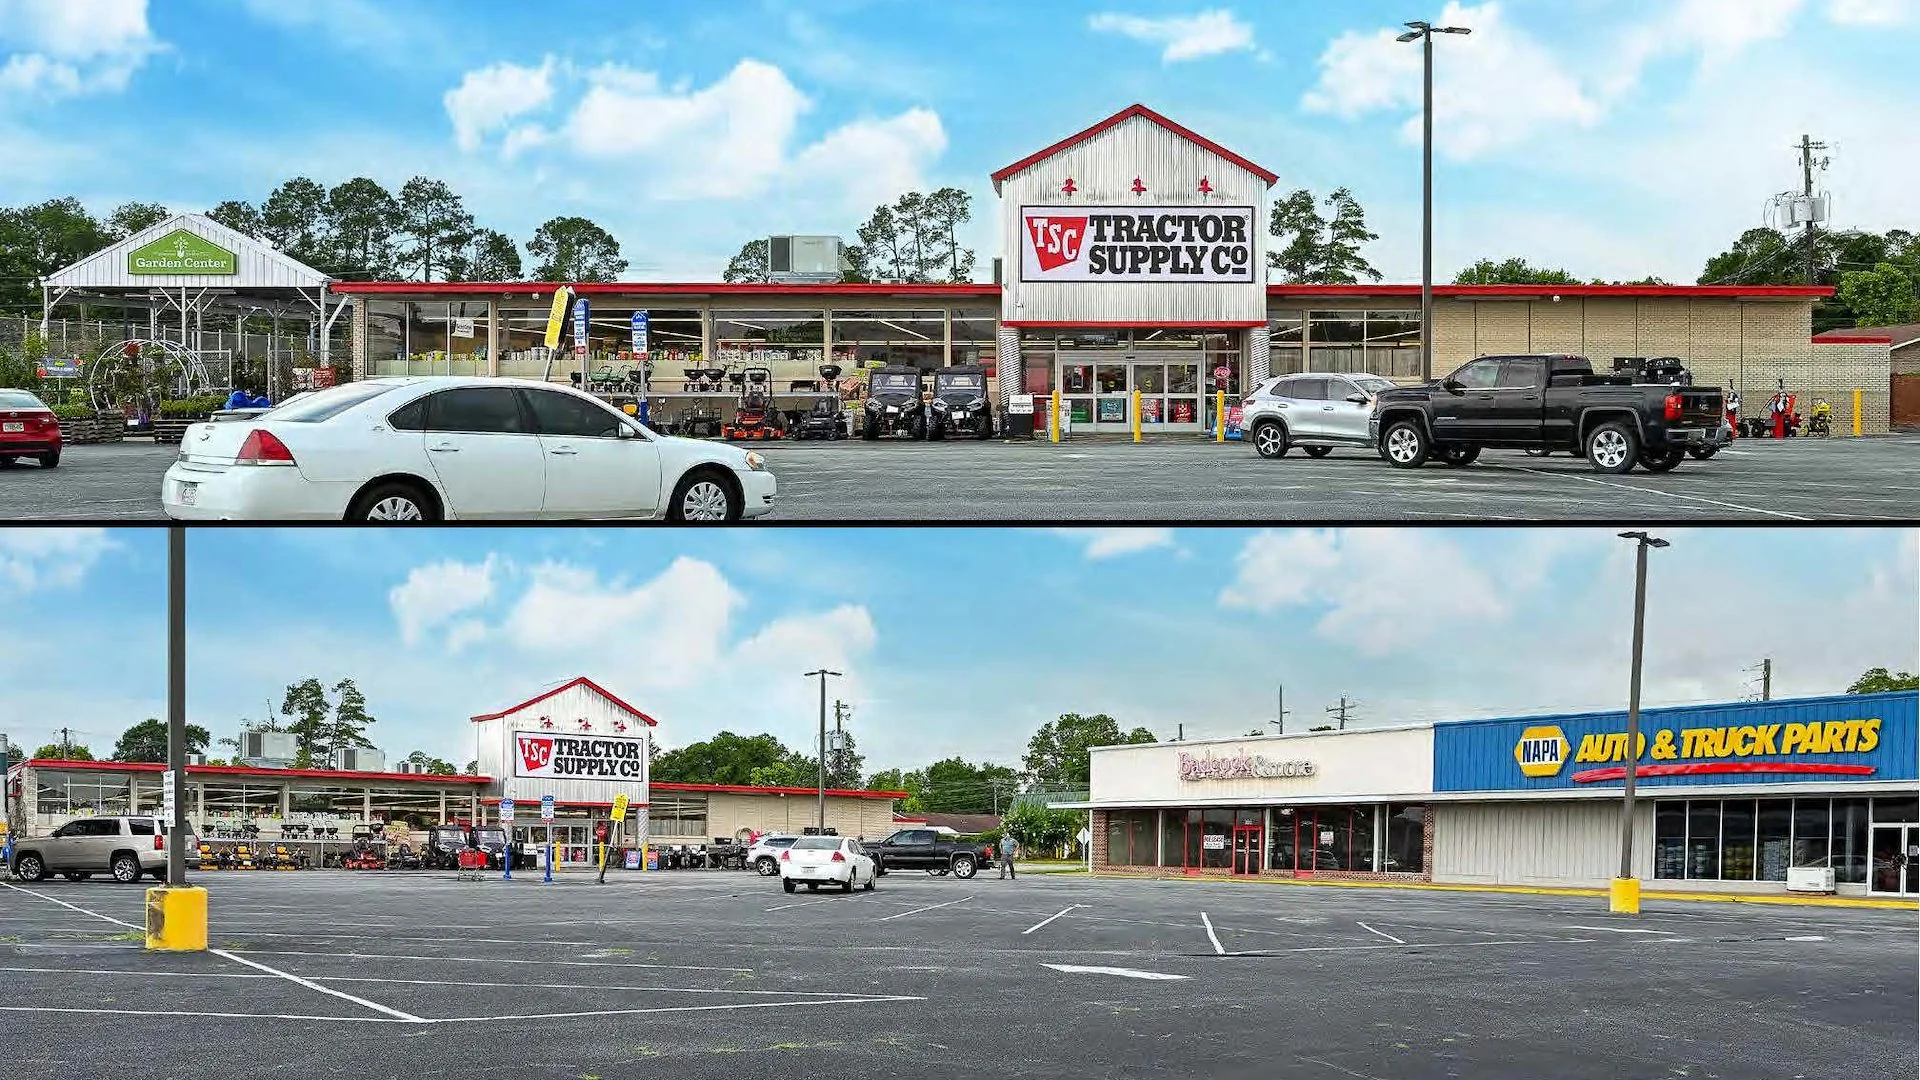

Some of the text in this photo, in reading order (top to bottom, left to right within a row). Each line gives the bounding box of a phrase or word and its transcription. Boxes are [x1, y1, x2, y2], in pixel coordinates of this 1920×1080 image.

[1032, 218, 1077, 260] TSC
[1089, 214, 1246, 243] TRACTOR
[136, 257, 227, 268] Garden Center
[1089, 245, 1208, 274] SUPPLY
[522, 739, 548, 766] TSC
[554, 738, 639, 760] TRACTOR
[1522, 739, 1559, 763] NAPA
[1650, 729, 1678, 760] &
[1681, 724, 1782, 759] TRUCK
[1781, 718, 1882, 755] PARTS
[554, 757, 619, 776] SUPPLY
[1178, 747, 1252, 775] Badcock
